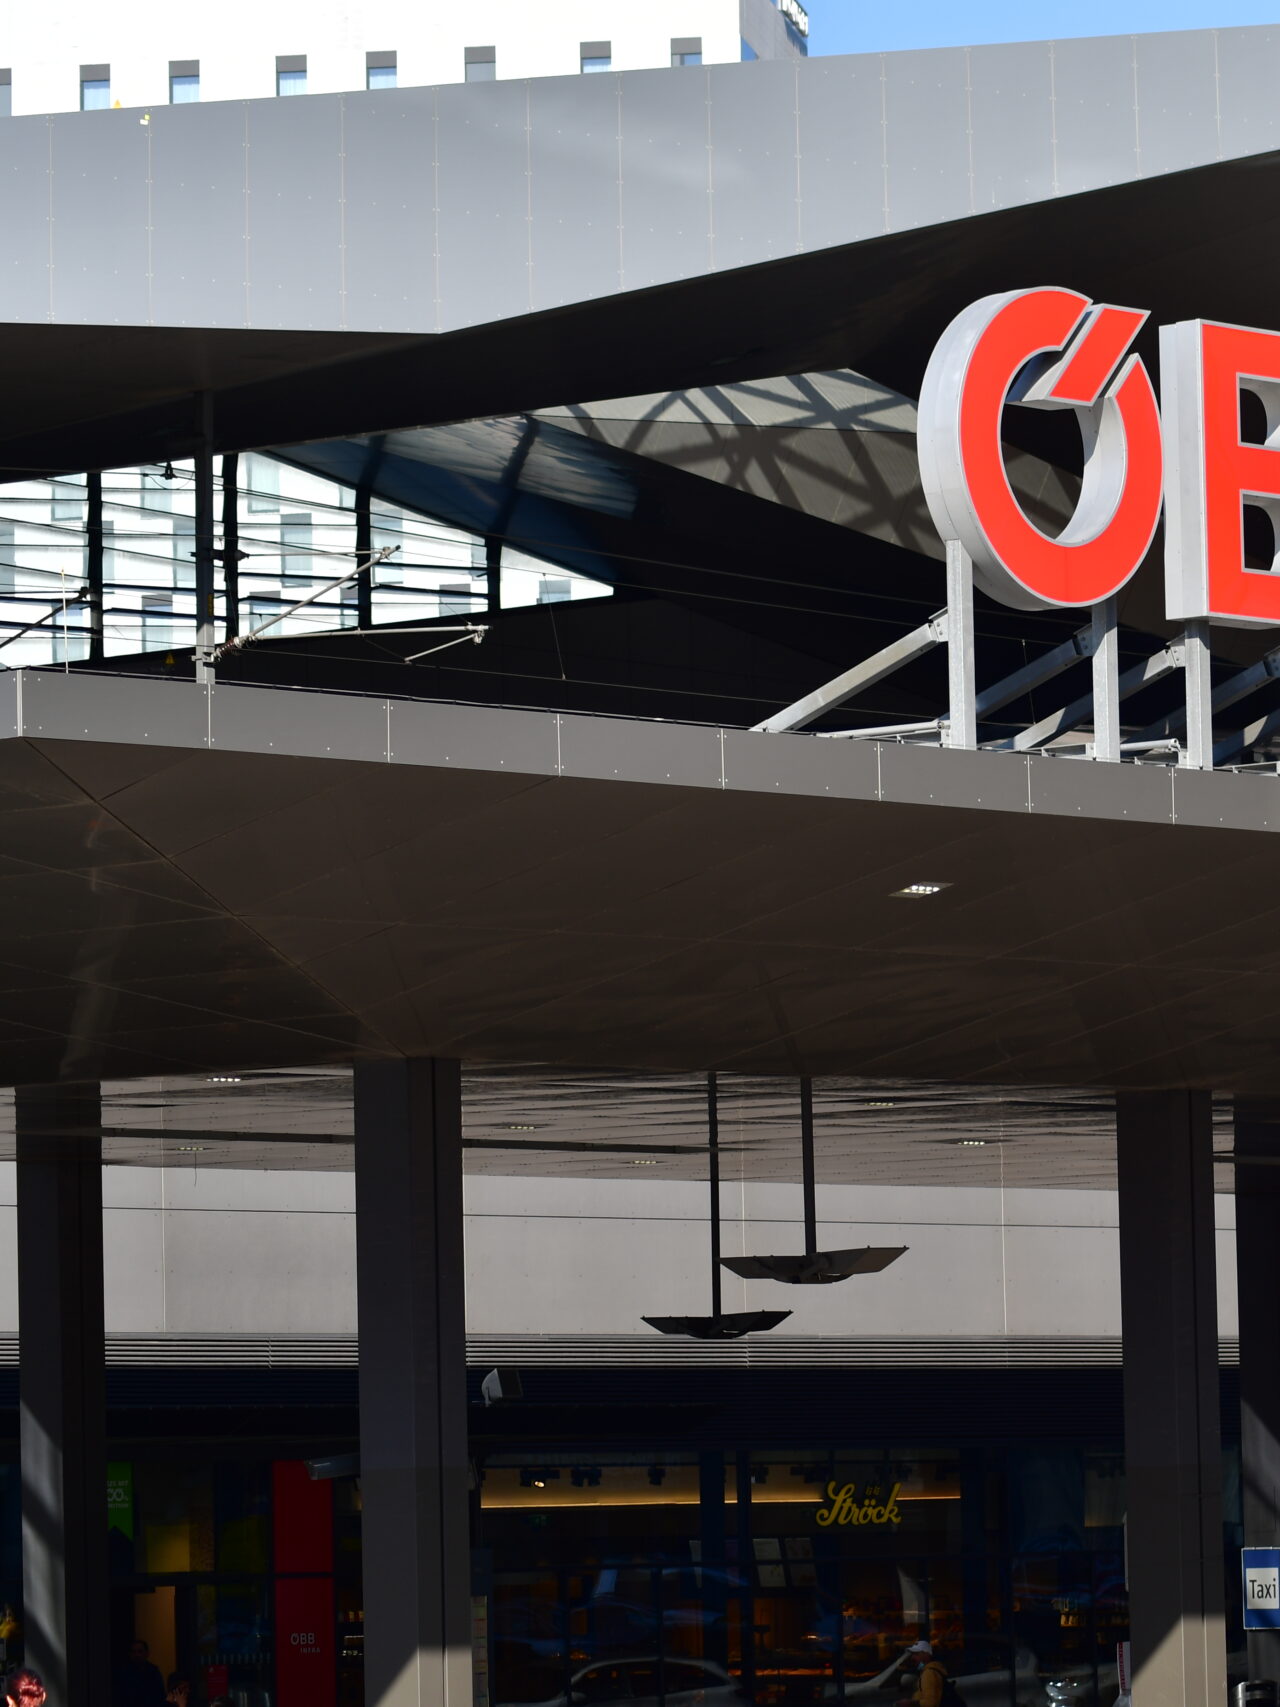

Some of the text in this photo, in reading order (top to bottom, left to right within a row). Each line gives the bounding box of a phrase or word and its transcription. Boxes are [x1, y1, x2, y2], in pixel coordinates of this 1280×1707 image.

[815, 1480, 903, 1527] Ströck
[1249, 1577, 1277, 1599] Taxi
[290, 1632, 315, 1646] ÖBB
